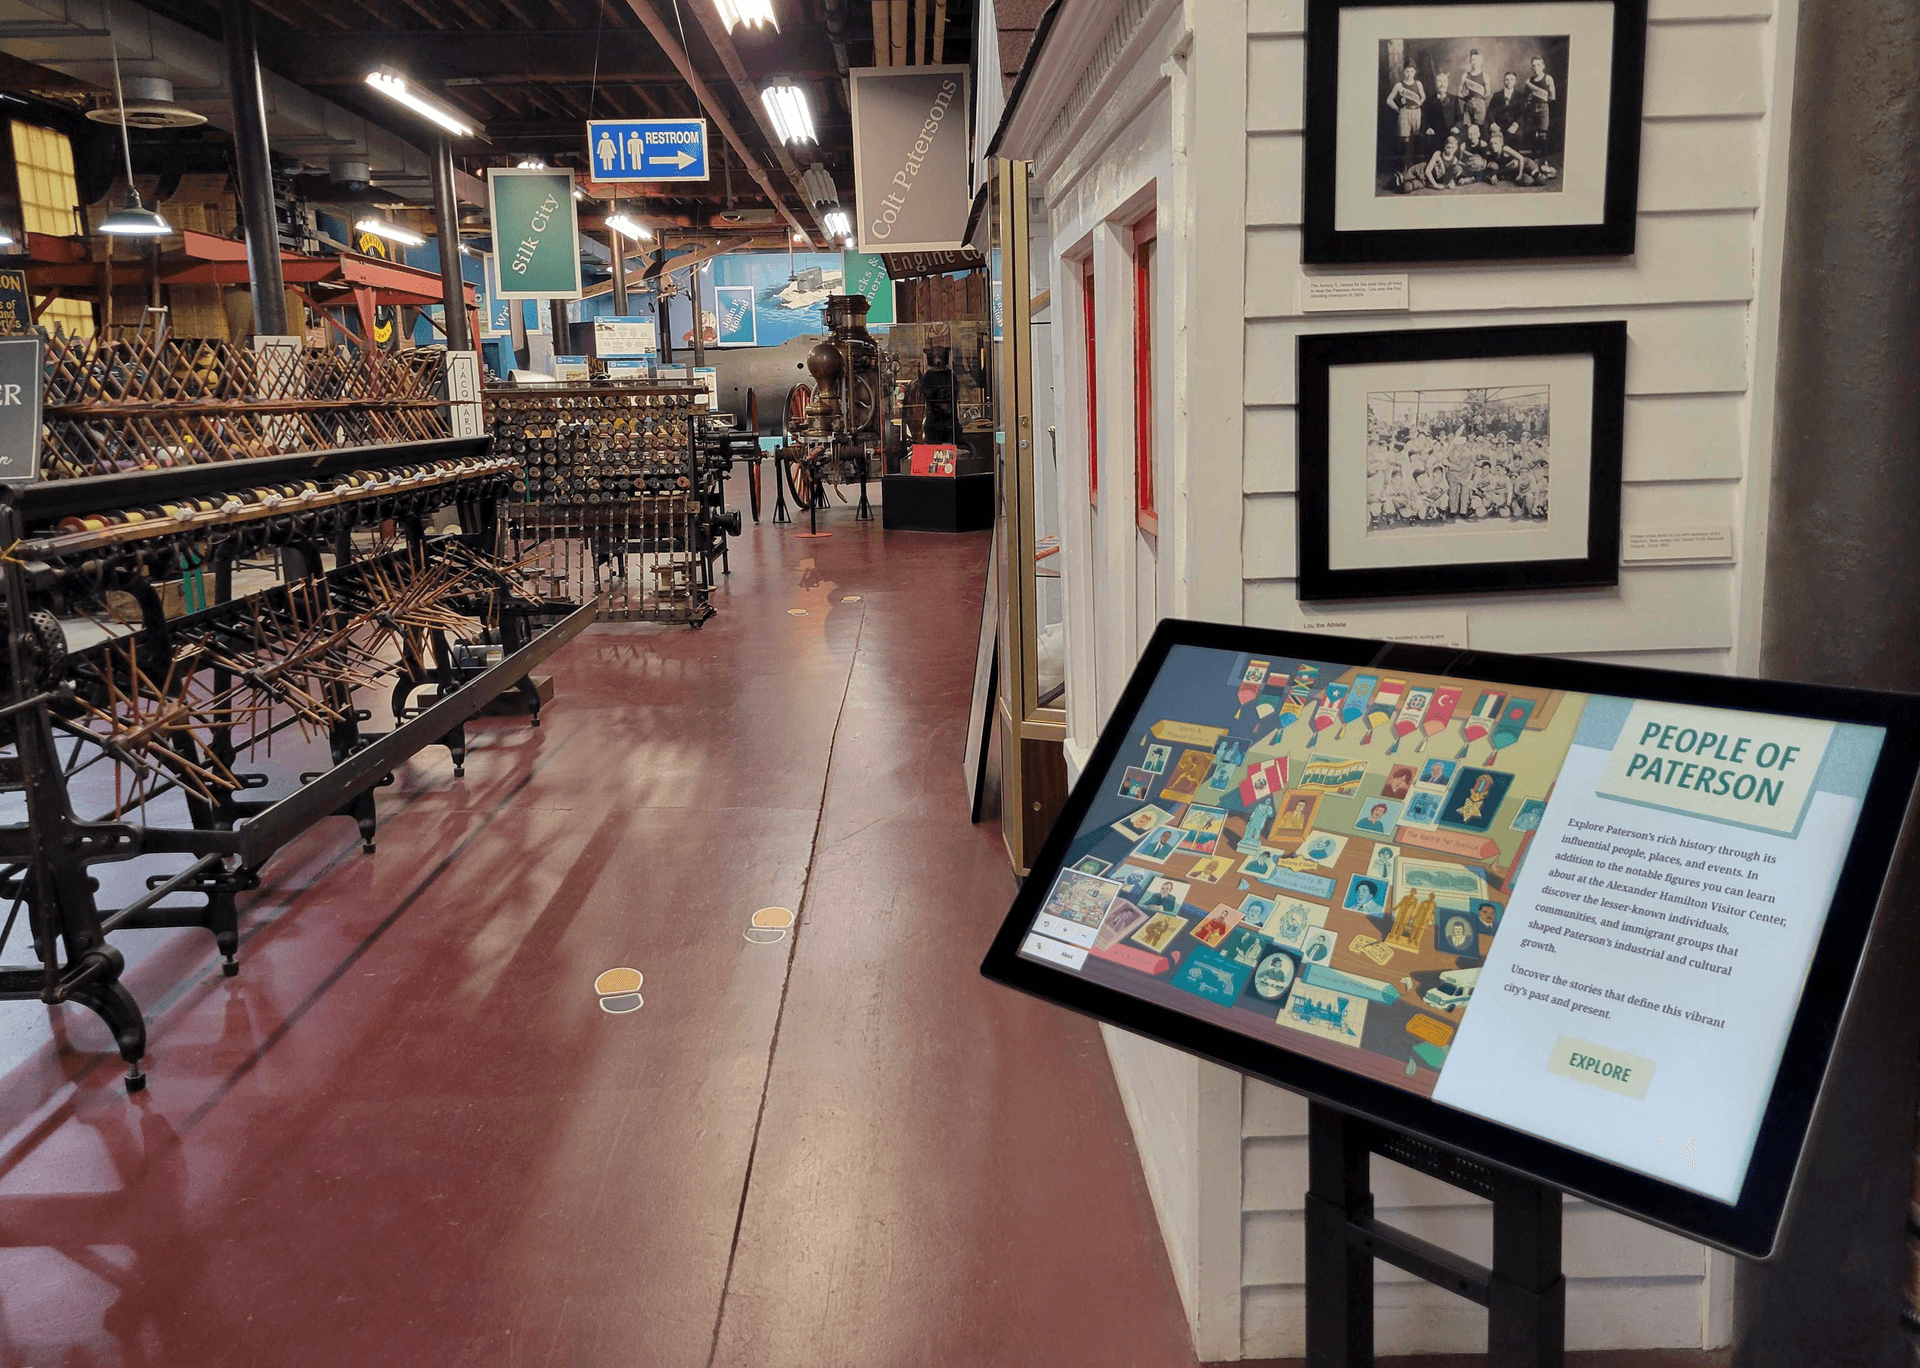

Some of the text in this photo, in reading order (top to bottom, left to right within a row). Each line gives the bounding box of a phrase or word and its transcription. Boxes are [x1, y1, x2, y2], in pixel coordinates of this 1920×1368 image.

[645, 131, 700, 145] RESTROOM
[872, 79, 957, 240] Colt Patersons
[512, 193, 559, 276] Silk City
[868, 256, 880, 267] &
[888, 252, 956, 273] Engine
[722, 307, 737, 329] John
[729, 299, 749, 333] Holland
[1639, 721, 1801, 772] PEOPLE OF
[1625, 752, 1785, 807] PATERSON
[1561, 834, 1759, 880] influential people, places, and events. In
[1567, 818, 1777, 864] Explore Paterson's rich history through its
[1548, 868, 1787, 927] about at the Alexander Hamilton Visitor Center,
[1555, 852, 1776, 904] addition to the notable figures you can learn
[1535, 903, 1739, 957] communities, and immigrant groups that
[1541, 886, 1730, 935] discover the lesser-known individuals,
[1061, 951, 1073, 960] About
[1520, 938, 1556, 954] growth.
[1528, 920, 1733, 976] shaped Paterson's industrial and cultural
[1503, 983, 1612, 1020] city's past and present.
[1511, 964, 1726, 1029] Uncover the stories that define this vibrant
[1569, 1052, 1632, 1082] EXPLORE
